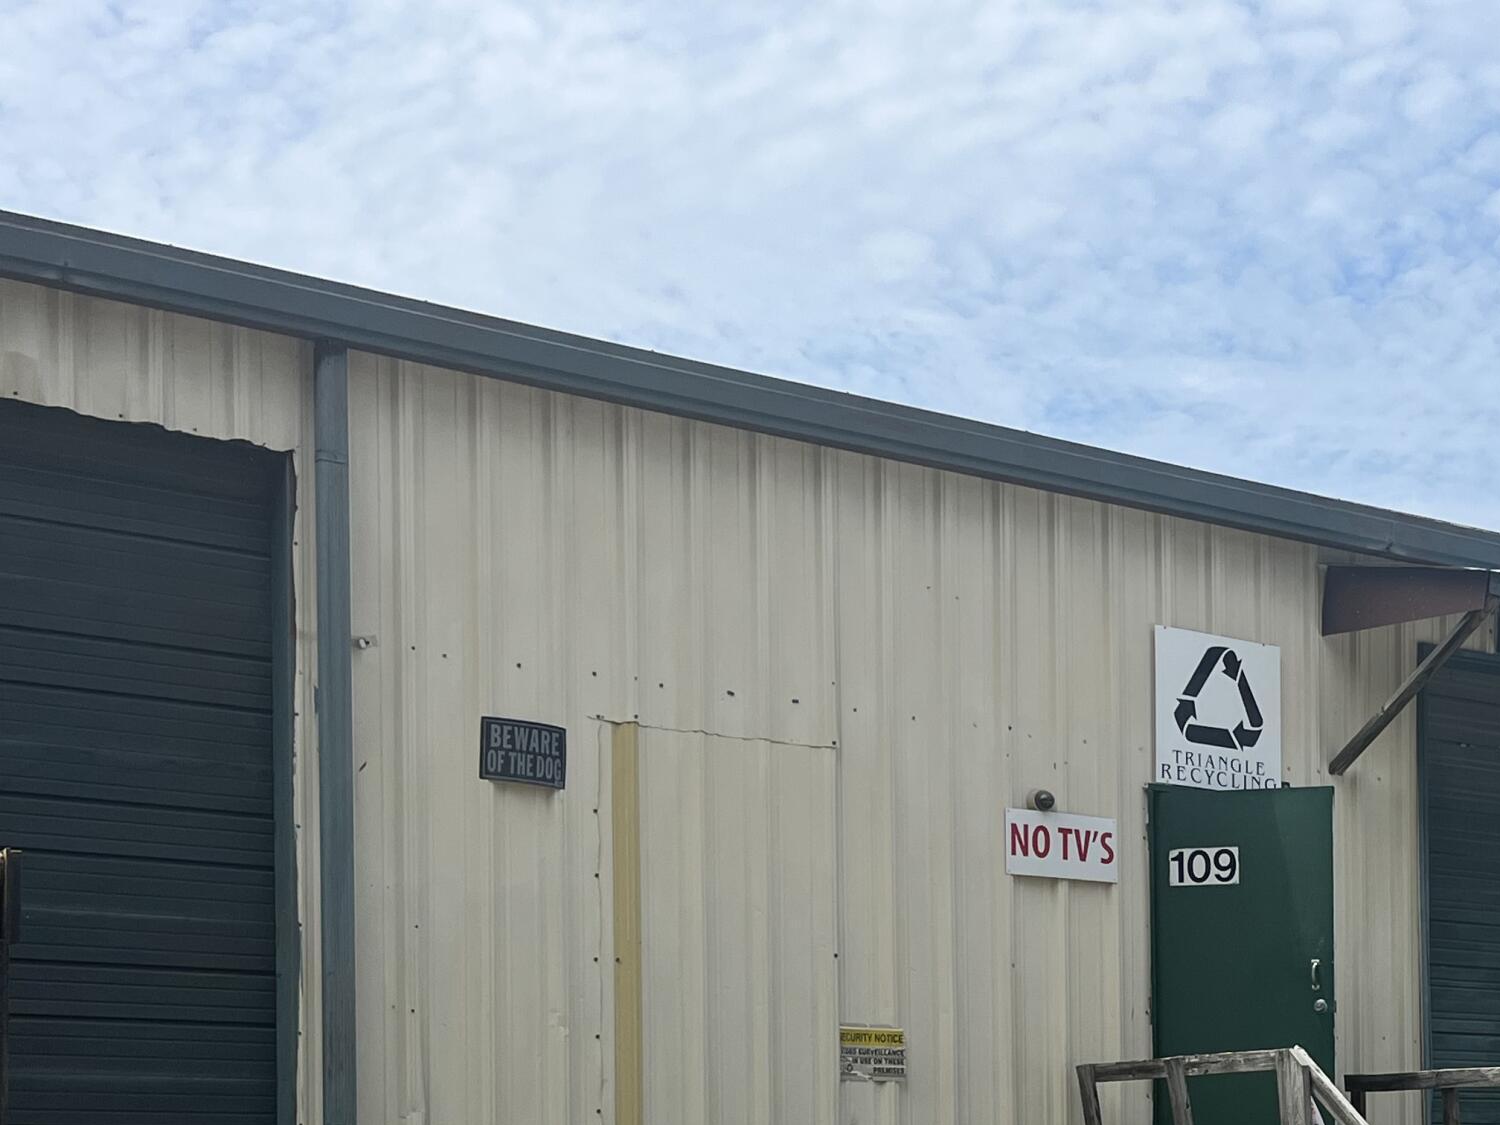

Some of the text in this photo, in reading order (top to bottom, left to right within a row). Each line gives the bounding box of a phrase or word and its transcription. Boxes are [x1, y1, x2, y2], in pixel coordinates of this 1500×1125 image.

[490, 724, 560, 756] BEWARE
[487, 750, 562, 781] OF THE DOG
[1161, 763, 1277, 790] RECYCLING
[1172, 750, 1265, 776] TRIANGLE
[1010, 822, 1115, 865] NO TV'S
[1170, 848, 1238, 883] 109
[841, 1032, 904, 1043] ECURITY NOTICE
